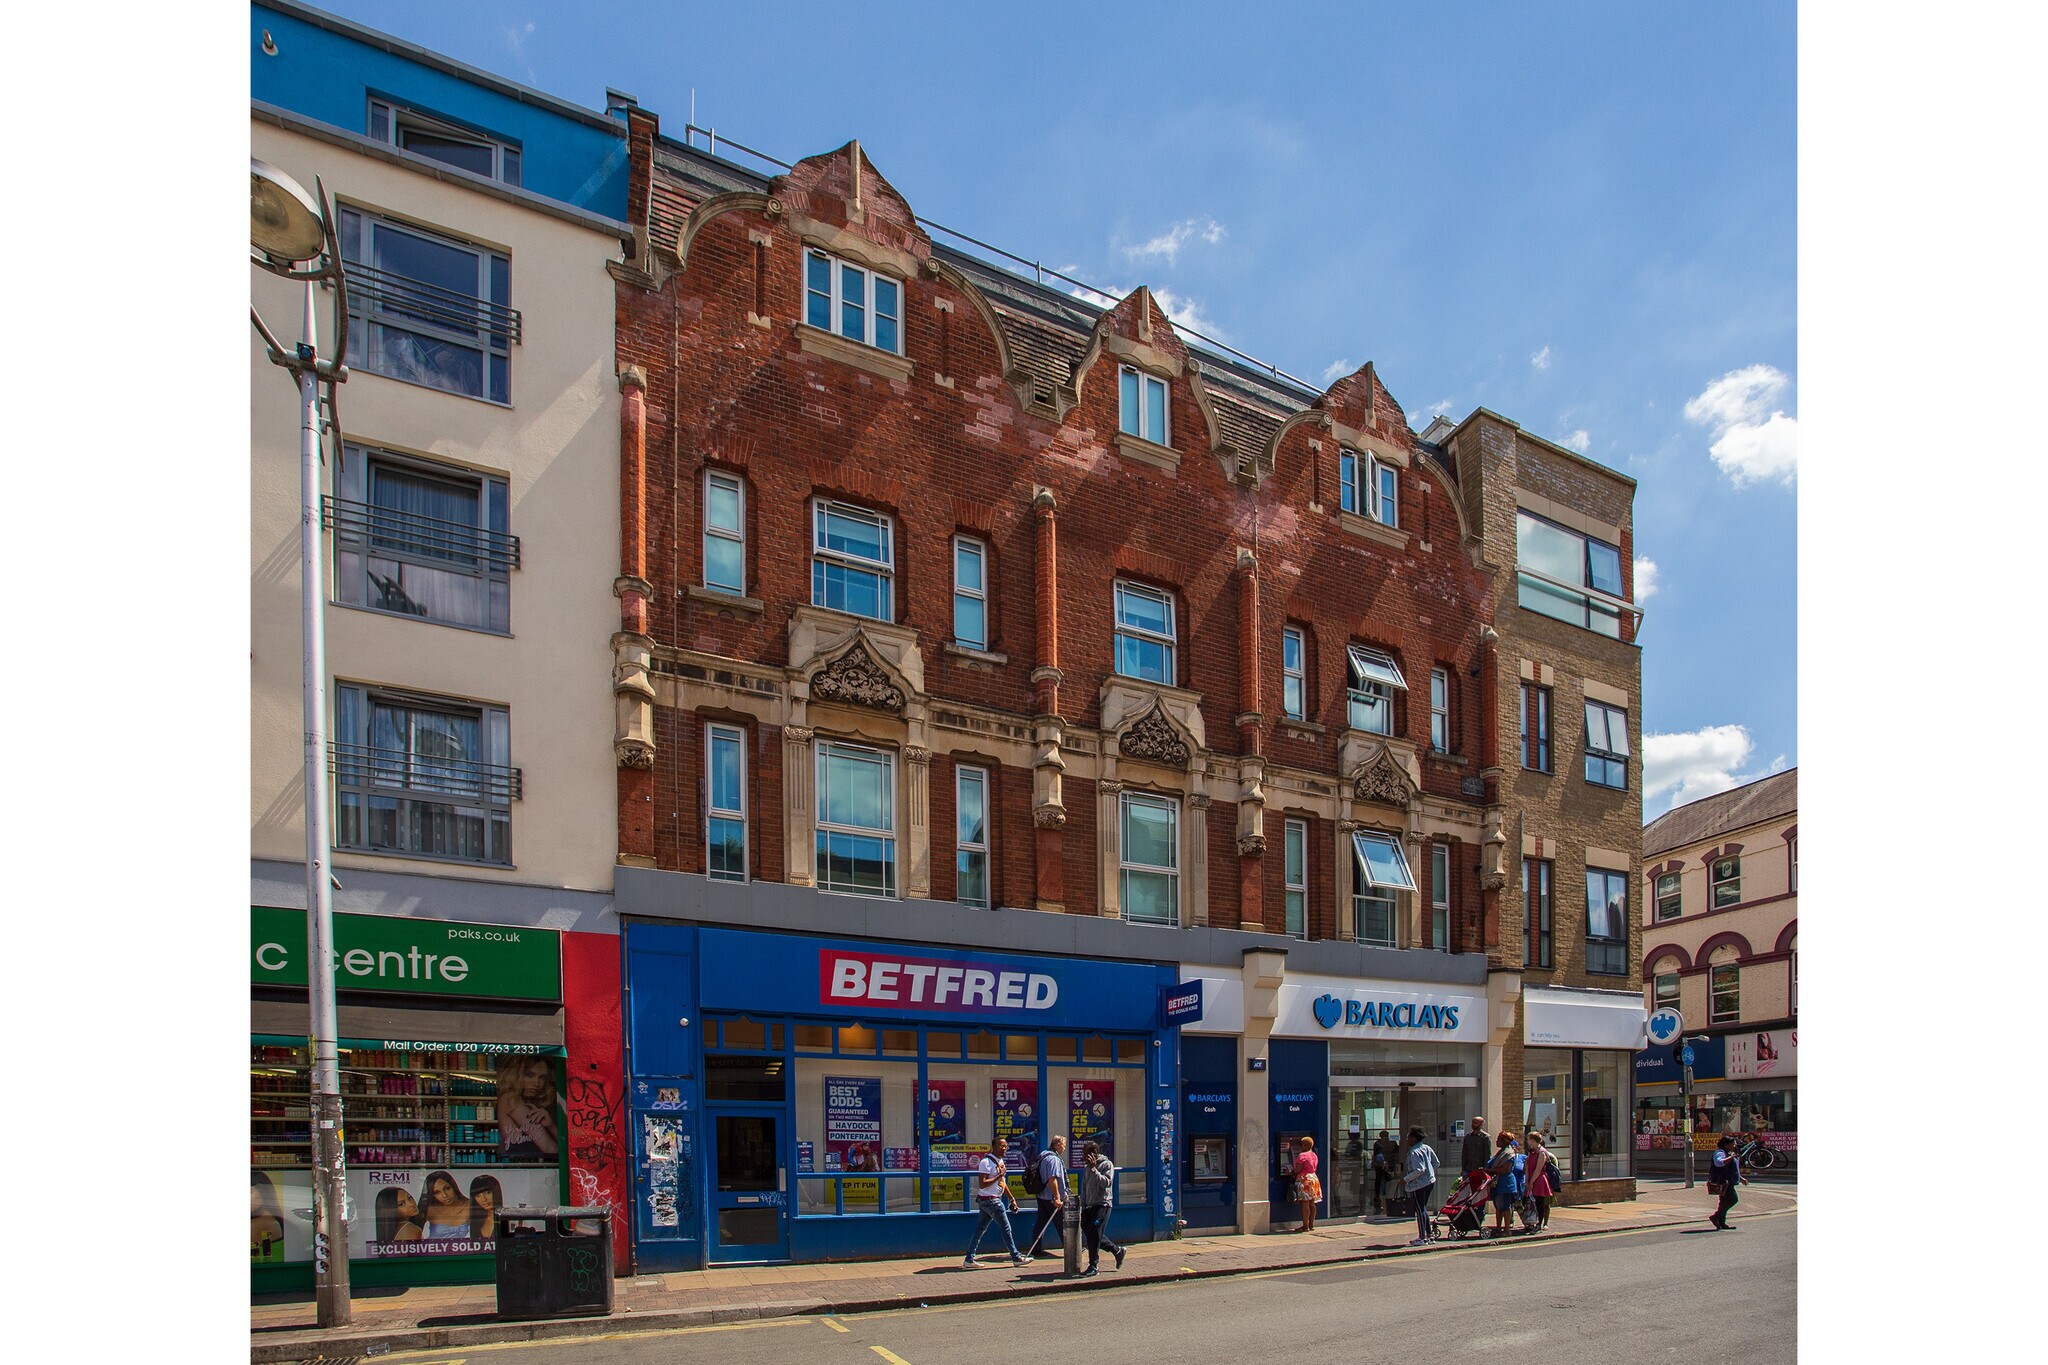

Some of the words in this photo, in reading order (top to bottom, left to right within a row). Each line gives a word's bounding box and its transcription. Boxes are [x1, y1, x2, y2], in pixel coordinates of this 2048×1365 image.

[448, 929, 520, 942] paks.co.uk
[256, 943, 288, 970] c
[830, 958, 1059, 1010] BETFRED
[1168, 993, 1198, 1010] BETFRED
[1345, 1000, 1459, 1029] BARCLAYS
[384, 1040, 409, 1050] Mail
[413, 1041, 451, 1051] Order:
[455, 1043, 478, 1052] 020
[482, 1043, 510, 1053] 7263
[513, 1045, 540, 1054] 2331
[1636, 1058, 1664, 1067] dividual
[830, 1085, 859, 1097] BEST
[996, 1089, 1018, 1100] £10
[1072, 1089, 1093, 1100] £10
[830, 1096, 862, 1107] ODDS
[1197, 1094, 1232, 1102] BARCLAYS
[1283, 1094, 1314, 1102] BARCLAYS
[836, 1122, 873, 1130] HAYDOCK
[996, 1115, 1013, 1127] £5
[1072, 1115, 1088, 1127] £5
[371, 1243, 448, 1255] EXCLUSIVELY
[451, 1242, 481, 1252] SOLD
